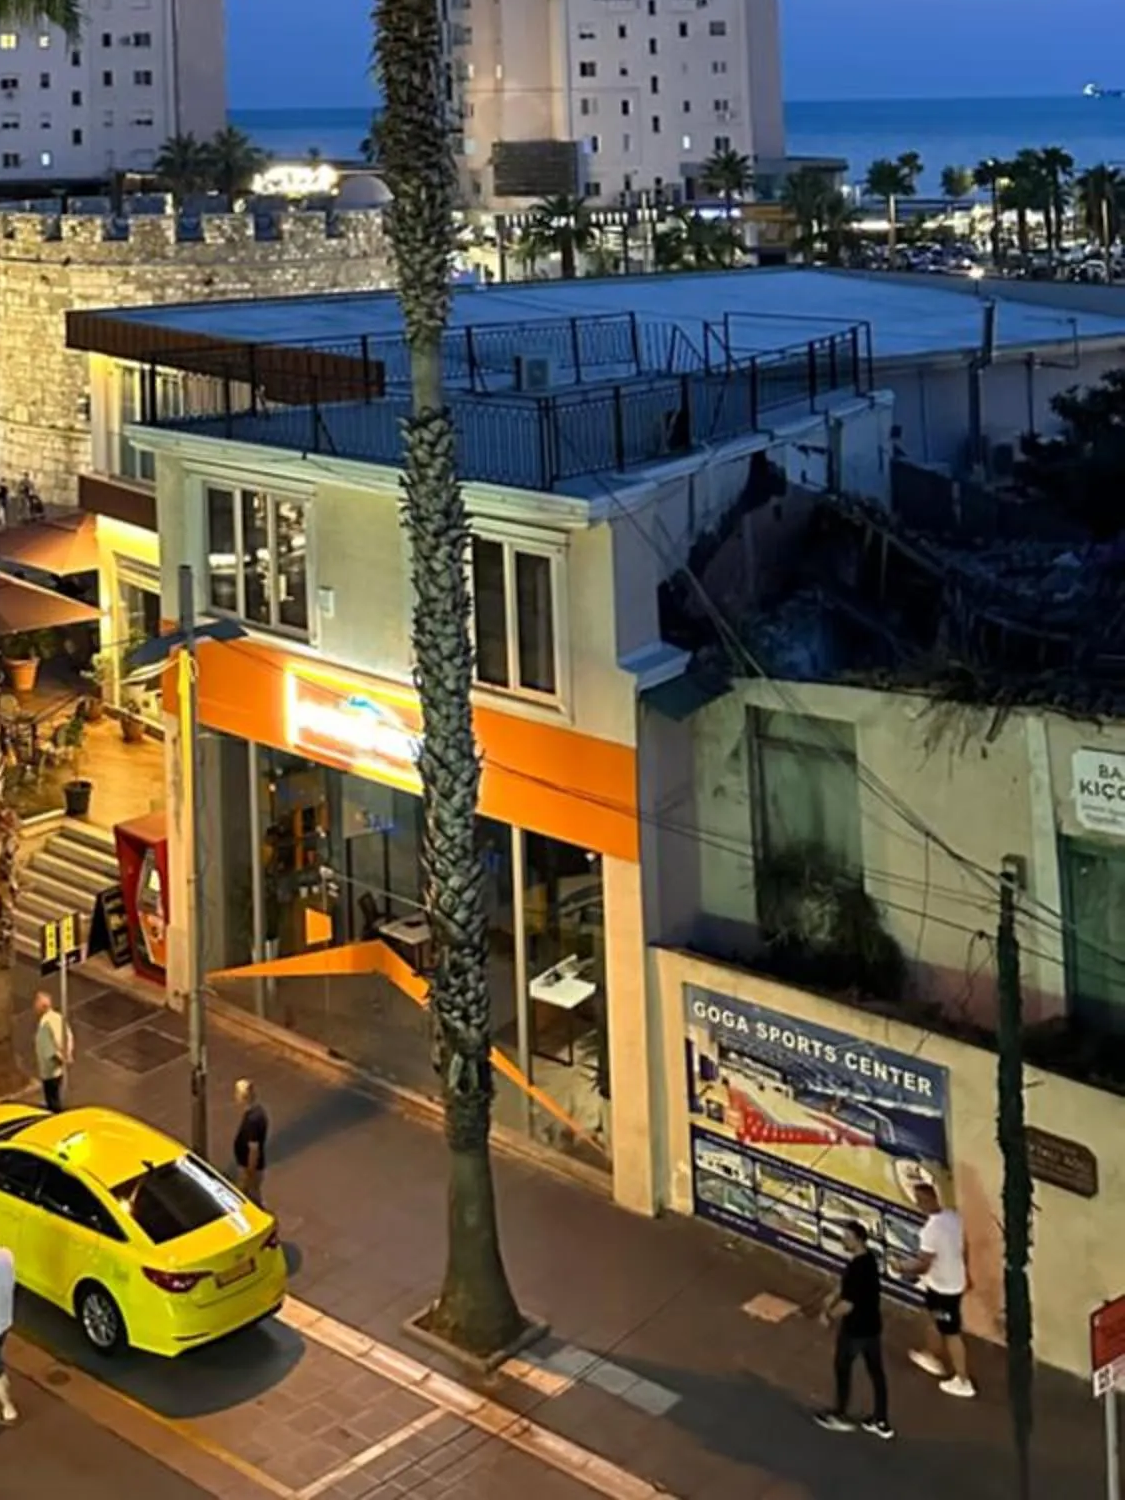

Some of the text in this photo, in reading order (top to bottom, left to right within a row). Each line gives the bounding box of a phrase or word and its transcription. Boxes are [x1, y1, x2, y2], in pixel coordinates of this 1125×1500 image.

[693, 1000, 933, 1096] GOGA SPORTS CENTER
